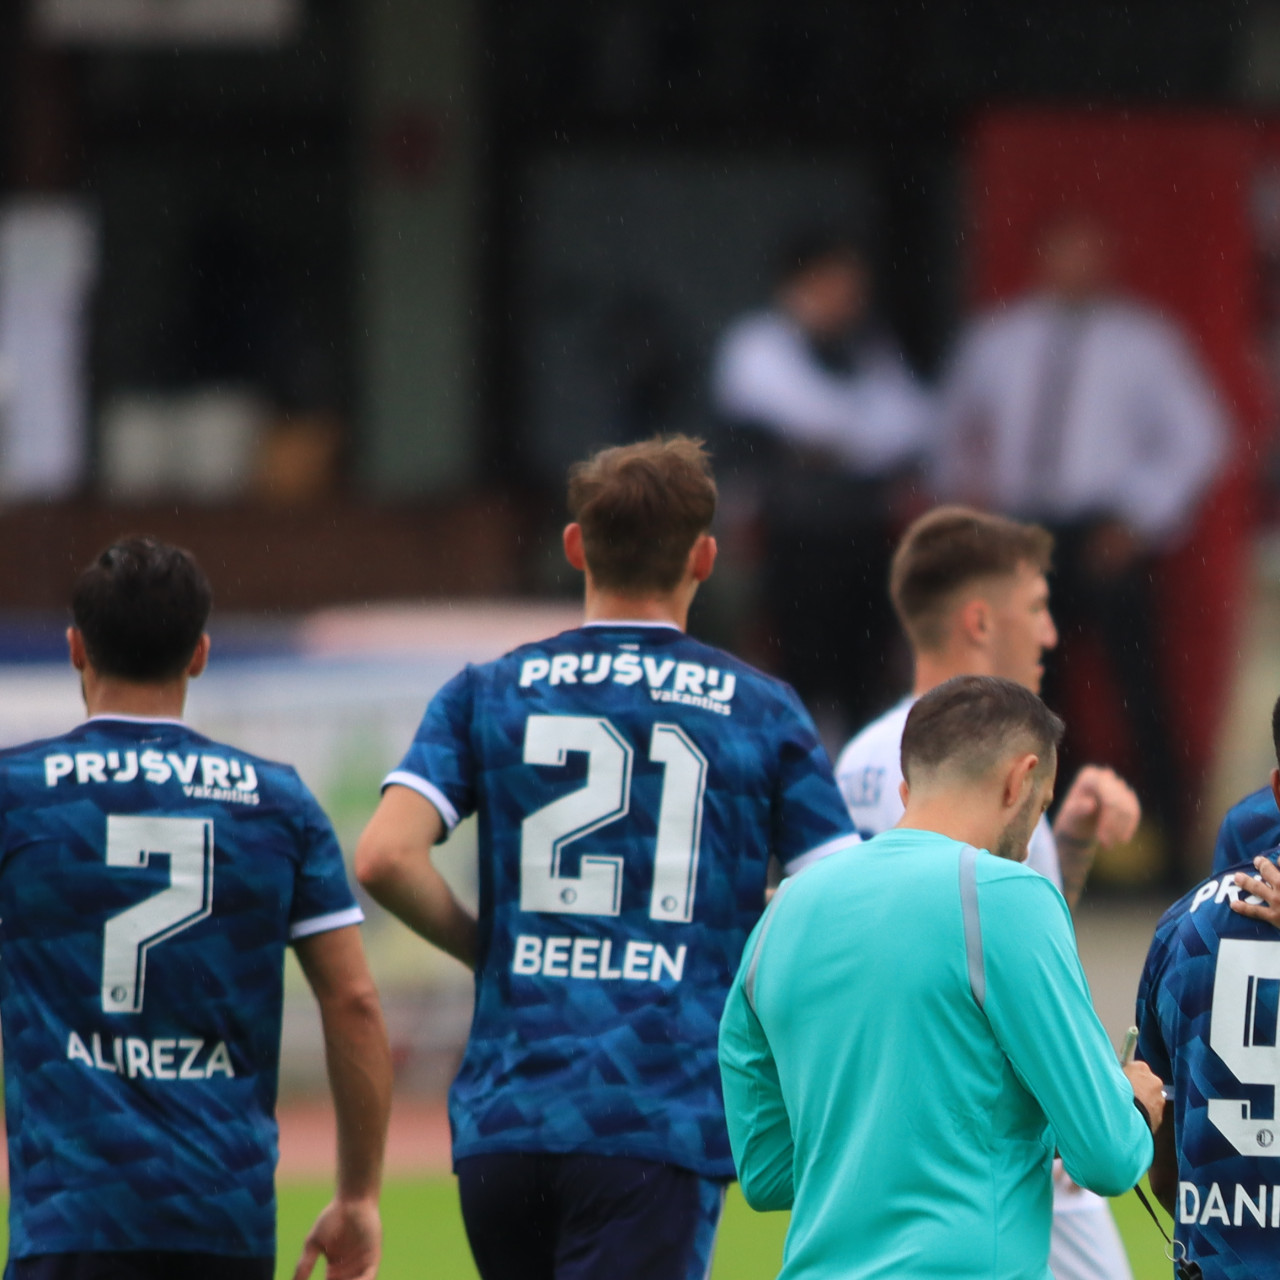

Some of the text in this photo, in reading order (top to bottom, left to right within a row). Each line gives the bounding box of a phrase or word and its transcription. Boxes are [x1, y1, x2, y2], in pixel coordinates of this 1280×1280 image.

[651, 688, 732, 716] vakanties
[183, 783, 260, 805] vakanties
[520, 714, 707, 923] 21
[102, 815, 214, 1013] 7
[512, 936, 687, 982] BEELEN
[67, 1031, 235, 1080] ALIREZA
